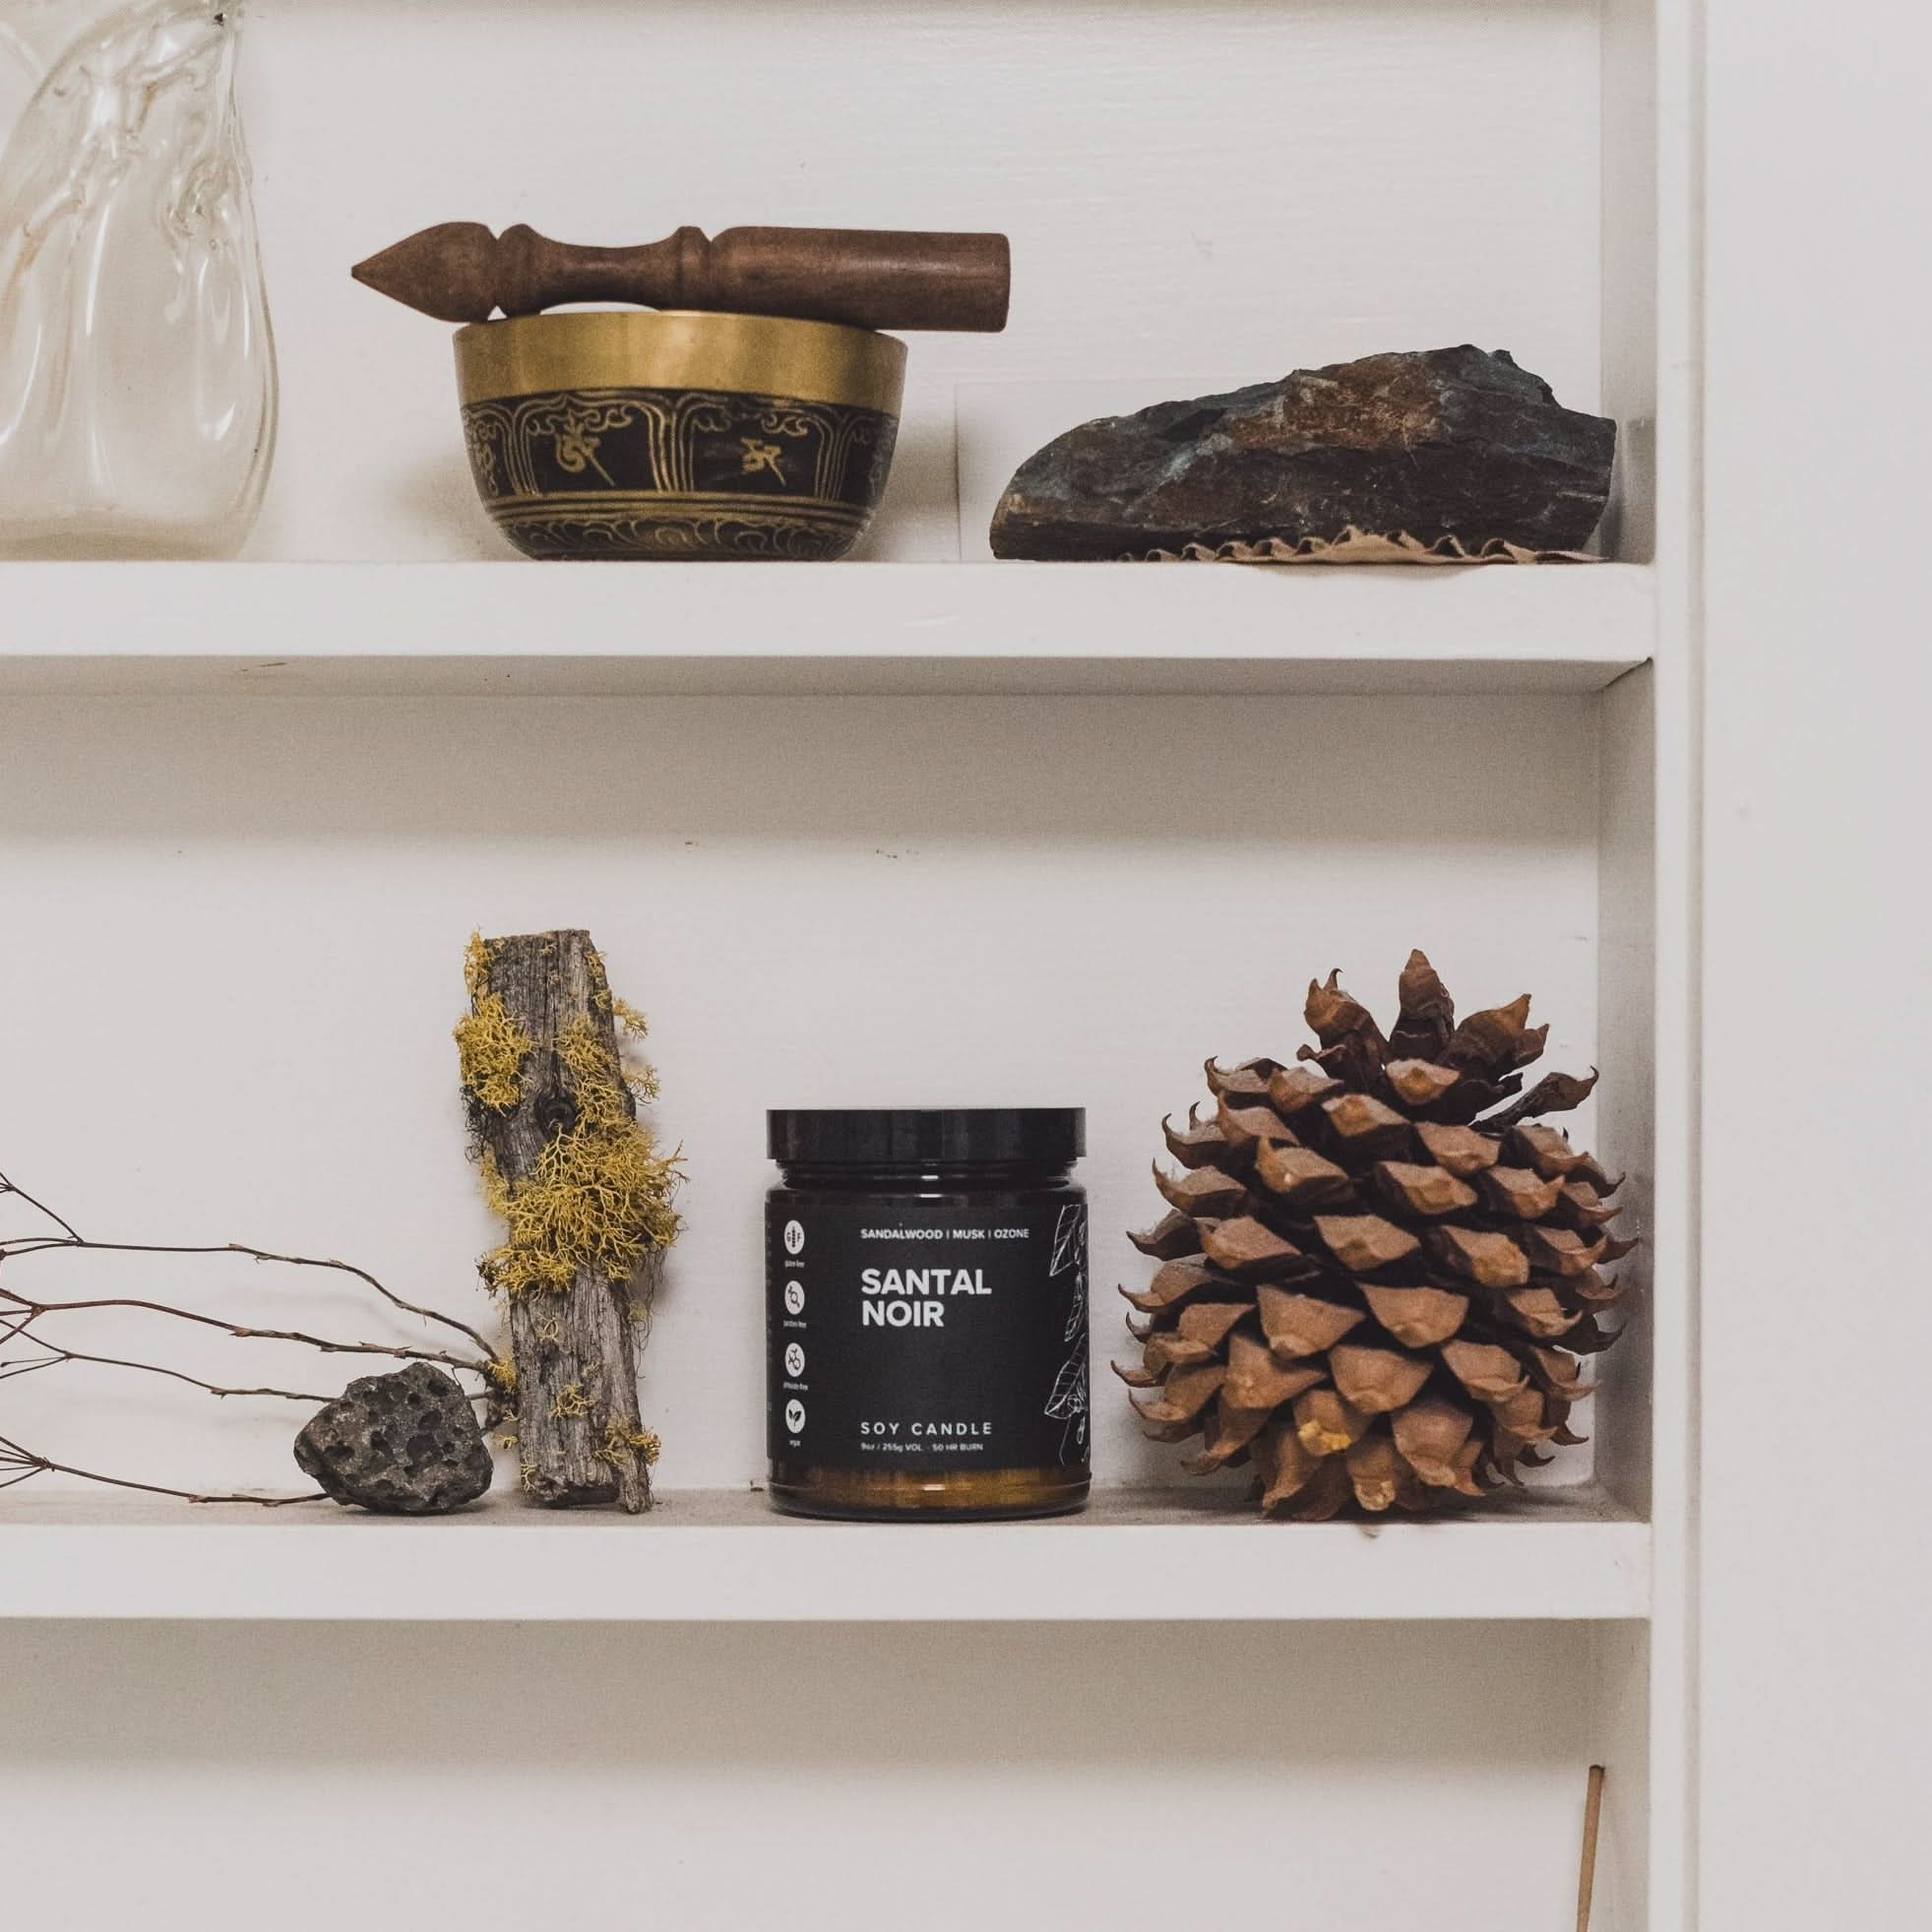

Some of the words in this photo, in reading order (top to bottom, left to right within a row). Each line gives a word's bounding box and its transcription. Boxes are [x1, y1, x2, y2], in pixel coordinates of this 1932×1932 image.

[860, 1228, 944, 1240] SANDALWOOD
[952, 1229, 985, 1240] MUSK
[993, 1228, 1030, 1239] OZONE
[861, 1268, 993, 1295] SANTAL
[862, 1300, 945, 1327] NOIR
[860, 1421, 900, 1435] SOY
[910, 1421, 992, 1436] CANDLE
